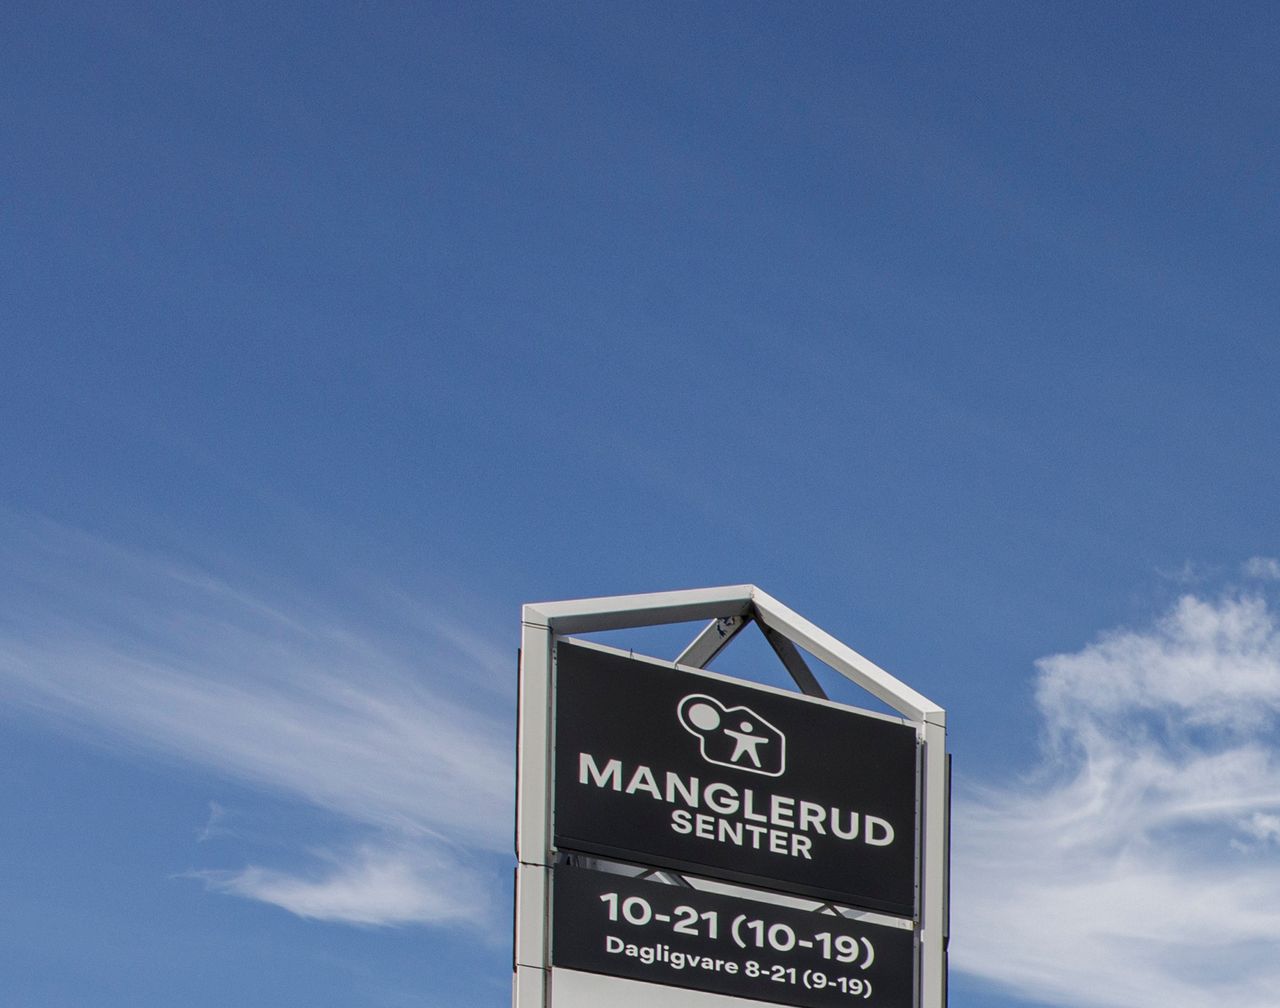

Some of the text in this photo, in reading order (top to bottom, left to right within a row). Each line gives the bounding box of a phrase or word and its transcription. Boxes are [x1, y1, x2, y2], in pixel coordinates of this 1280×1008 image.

[579, 752, 895, 847] MANGLERUD
[671, 809, 812, 860] SENTER
[600, 892, 875, 971] 10-21 (10-19)
[606, 935, 872, 999] Dagligvare 8-21 (9-19)
